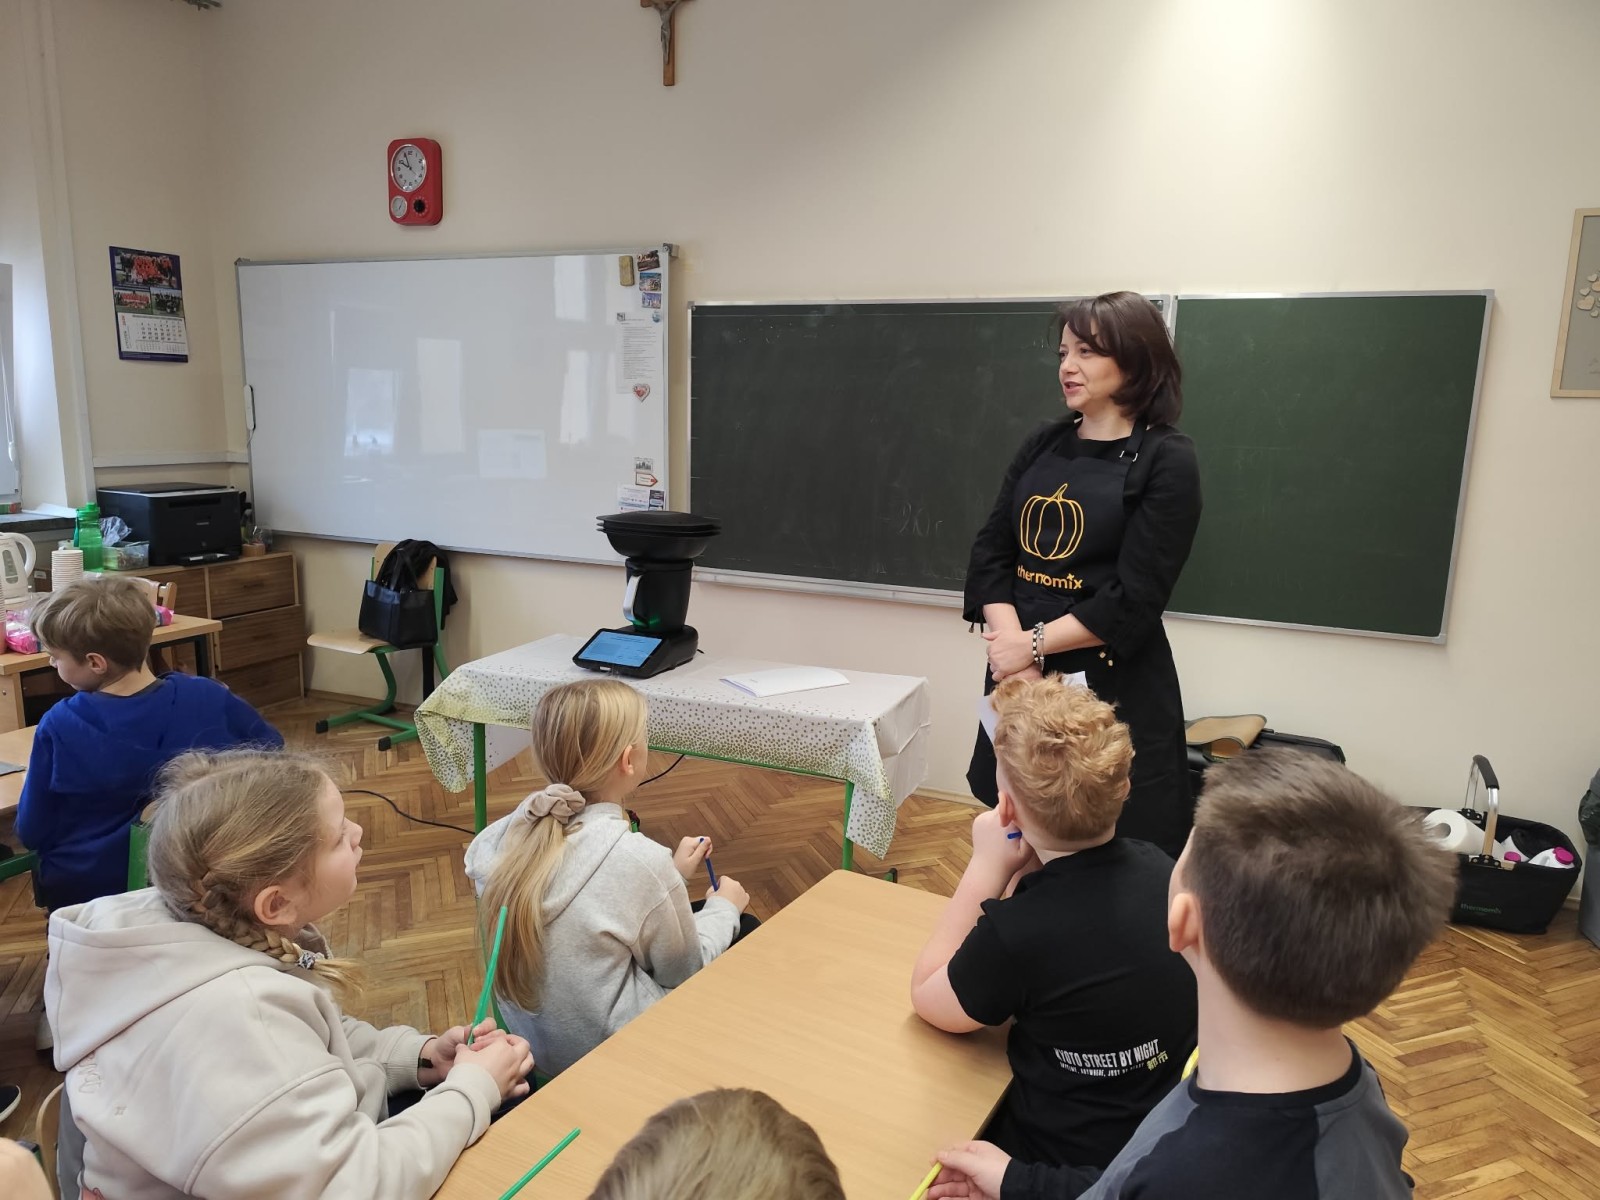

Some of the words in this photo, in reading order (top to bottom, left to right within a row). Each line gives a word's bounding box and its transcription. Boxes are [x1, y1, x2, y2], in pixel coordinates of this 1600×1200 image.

[1054, 1047, 1083, 1067] KYOTO
[1082, 1052, 1118, 1068] STREET
[1118, 1049, 1133, 1067] BY
[1133, 1038, 1159, 1063] NIGHT
